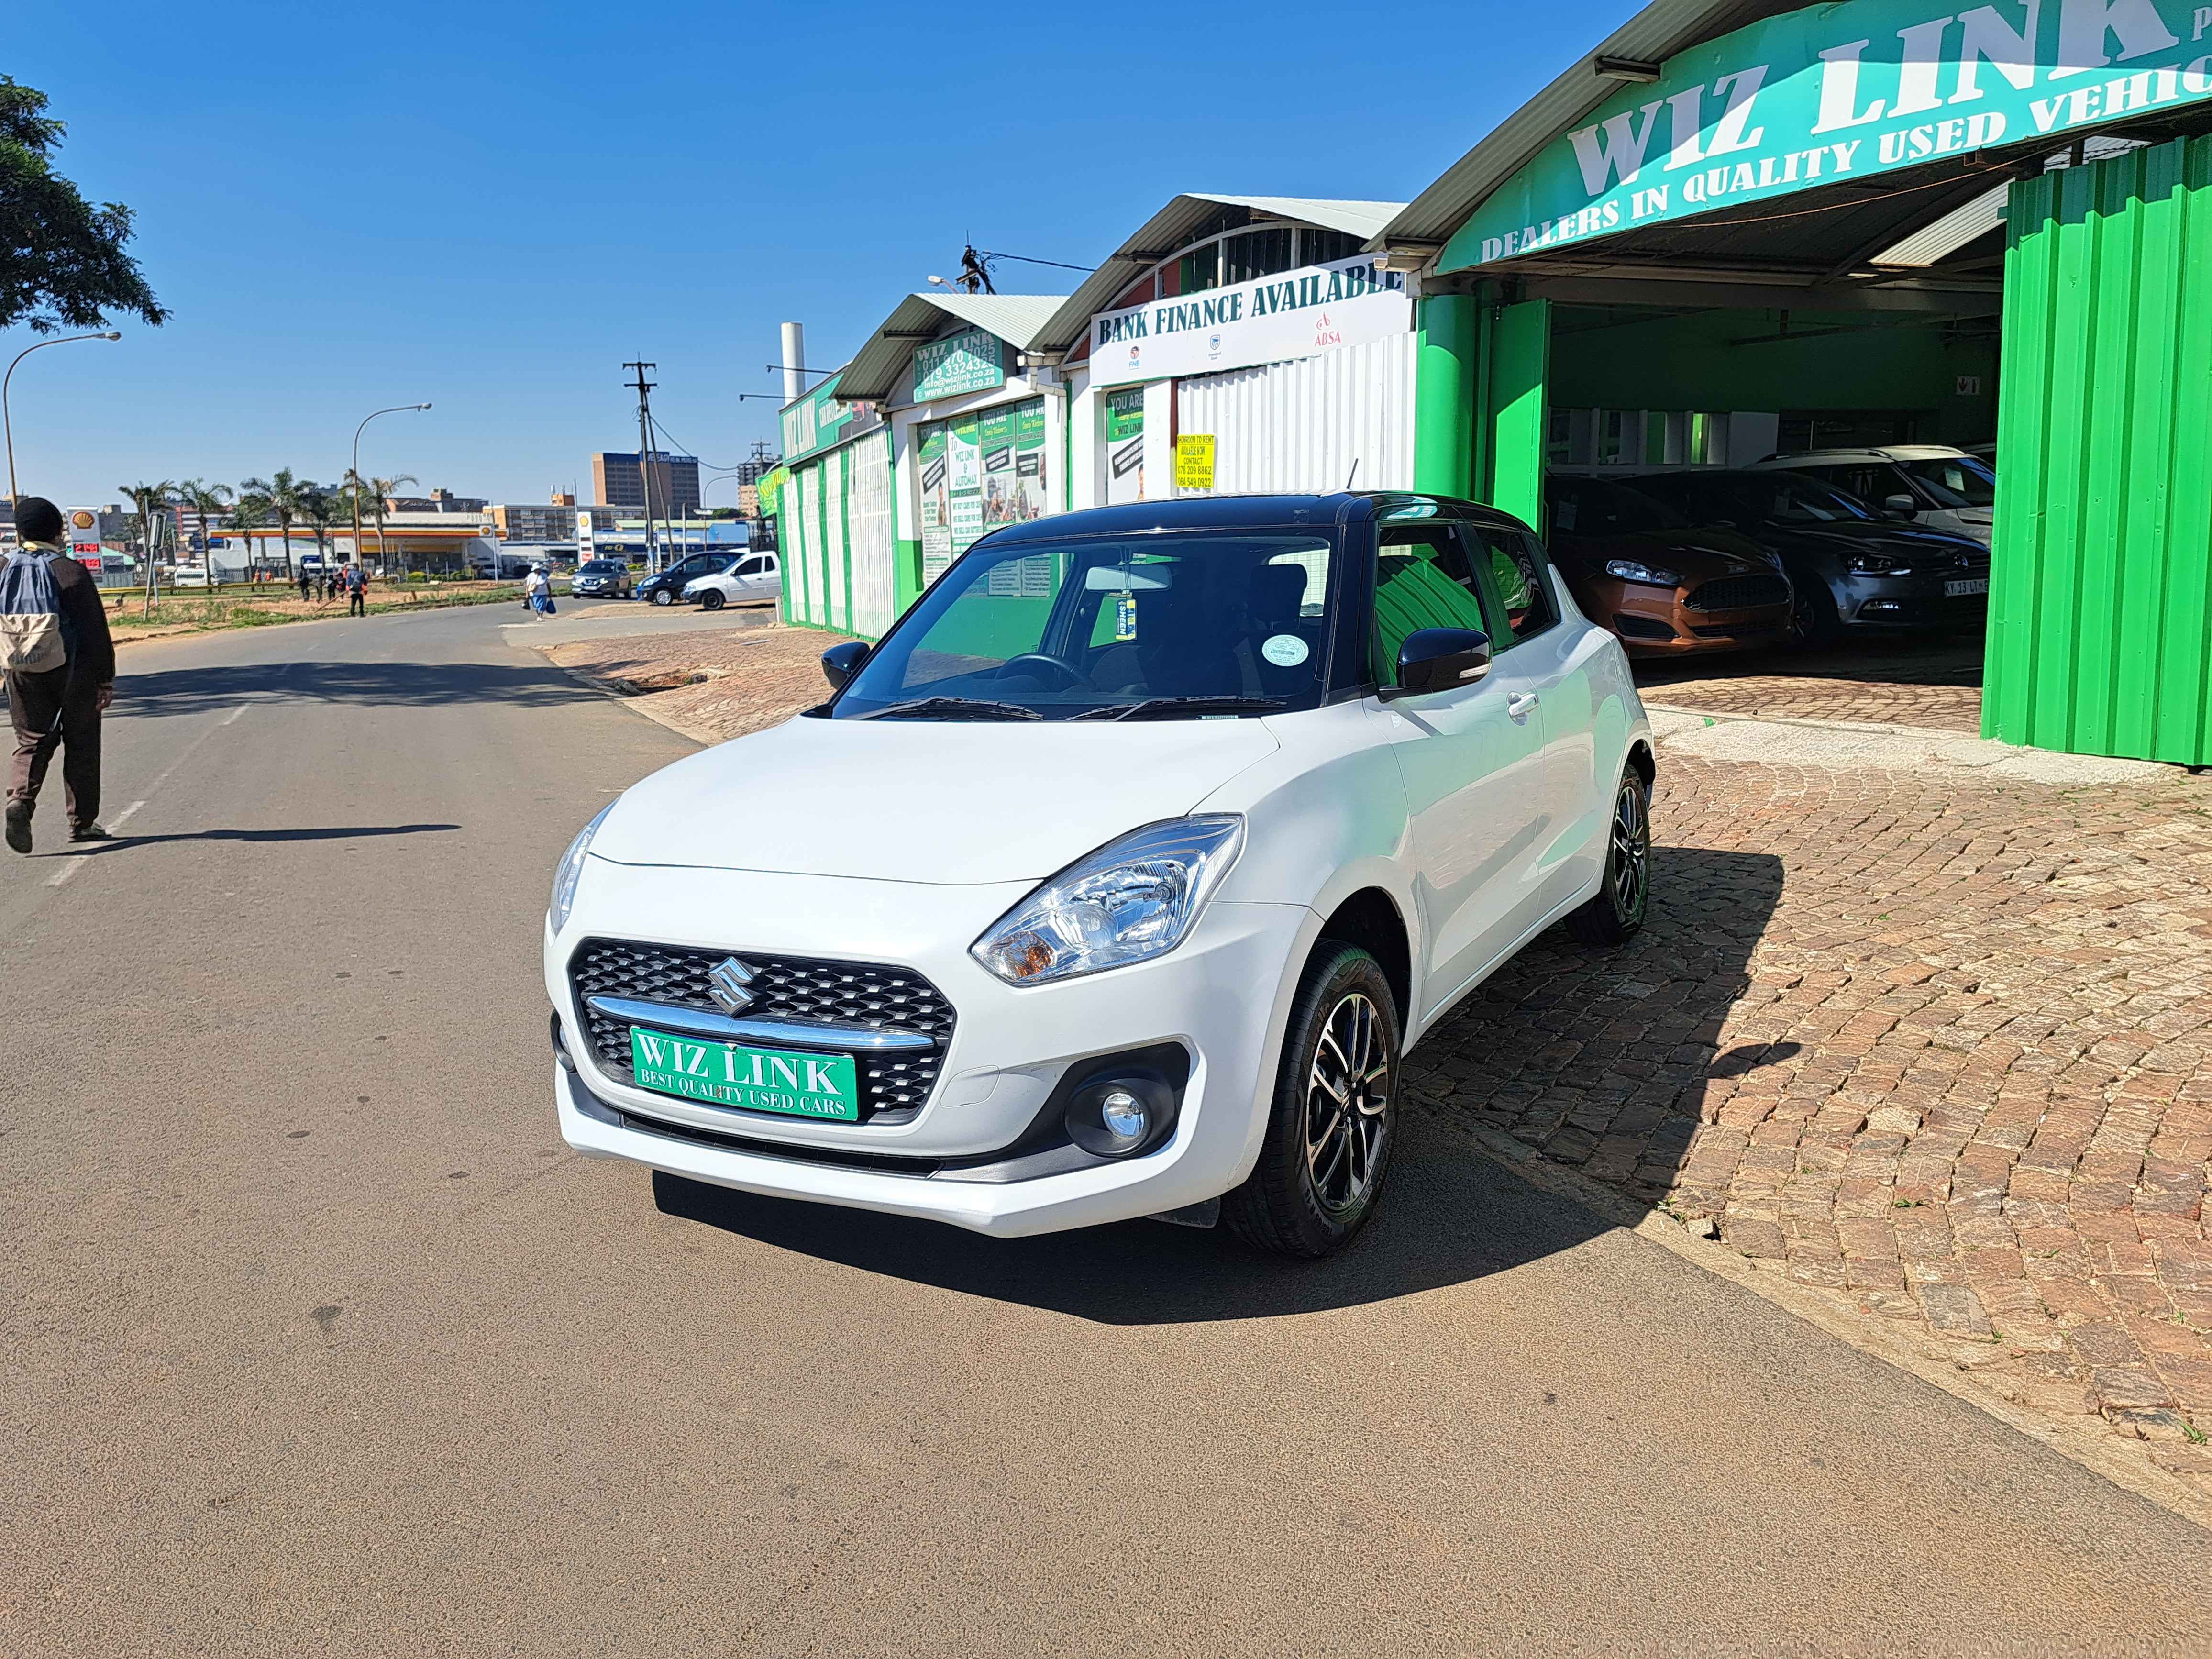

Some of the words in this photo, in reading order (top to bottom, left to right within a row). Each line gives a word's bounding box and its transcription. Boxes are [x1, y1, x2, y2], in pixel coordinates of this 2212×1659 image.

[1567, 63, 1771, 198] WIZ
[1811, 0, 2180, 136] LINK
[1481, 198, 1620, 265] DEALERS
[1631, 182, 1669, 219] IN
[1683, 138, 1862, 205] QUALITY
[1879, 111, 2006, 164] USED
[1099, 311, 1148, 346] BANK
[1155, 292, 1243, 335] FINANCE
[1251, 262, 1404, 318] AVAILABLE
[917, 343, 947, 362] WIZ
[953, 332, 995, 353] LINK
[1315, 331, 1341, 348] ABSA
[923, 356, 940, 371] 011
[967, 343, 995, 360] 7025
[945, 354, 995, 377] 3324325
[1129, 360, 1140, 368] FNB
[924, 367, 995, 389] info@wizlink.co.za
[924, 376, 995, 399] www.wizlink.co.za
[1021, 403, 1034, 419] YOU
[1110, 395, 1128, 411] YOU
[1129, 392, 1143, 409] ARE
[983, 413, 995, 426] YOU
[996, 409, 1007, 423] ARE
[1118, 424, 1129, 436] WIZ
[1130, 422, 1143, 434] LINK
[1197, 435, 1202, 443] TO
[1203, 435, 1215, 443] RENT
[1178, 465, 1186, 475] 078
[1187, 465, 1196, 475] 209
[1183, 457, 1204, 465] CONTACT
[1197, 477, 1212, 487] 0922
[1958, 581, 1966, 594] 13
[1969, 580, 1978, 593] LT
[635, 1032, 710, 1078] WIZ
[721, 1049, 844, 1096] LINK
[641, 1068, 674, 1088] BEST
[678, 1076, 744, 1103] QUALITY
[748, 1089, 795, 1110] USED
[799, 1096, 846, 1117] CARS
